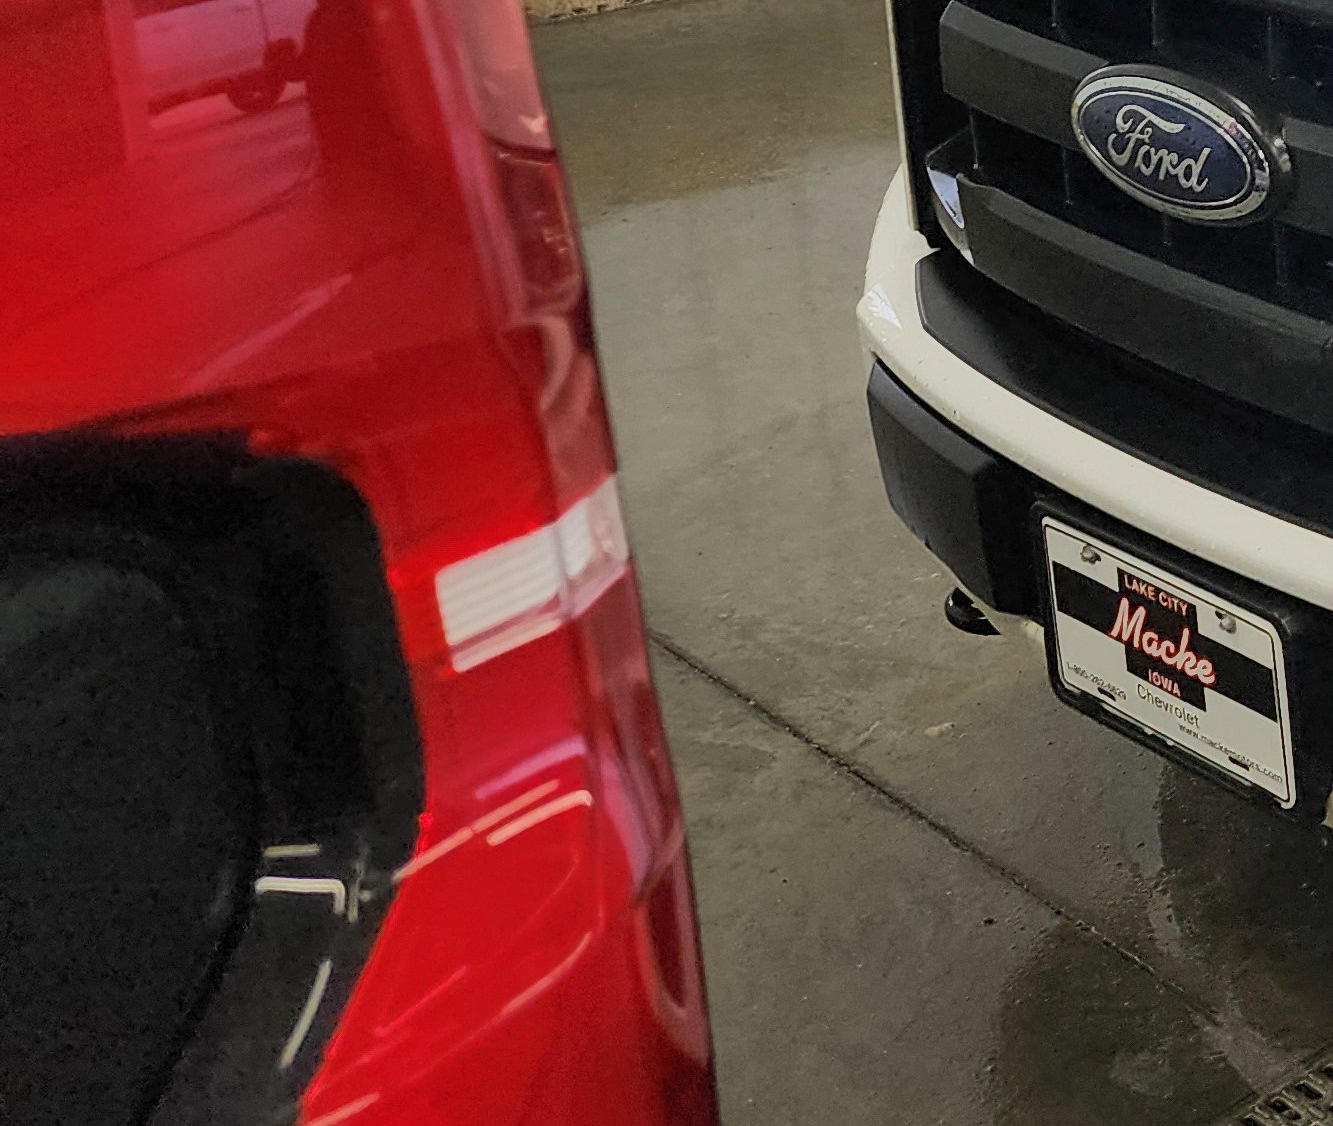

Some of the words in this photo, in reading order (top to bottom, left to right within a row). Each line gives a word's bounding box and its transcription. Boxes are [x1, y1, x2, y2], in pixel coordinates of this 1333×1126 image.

[1107, 104, 1212, 193] Ford
[1123, 574, 1156, 601] LAKE
[1158, 590, 1188, 617] CITY
[1110, 597, 1217, 686] Macke
[1147, 670, 1181, 697] IOWA
[1137, 684, 1201, 729] Chevrolet
